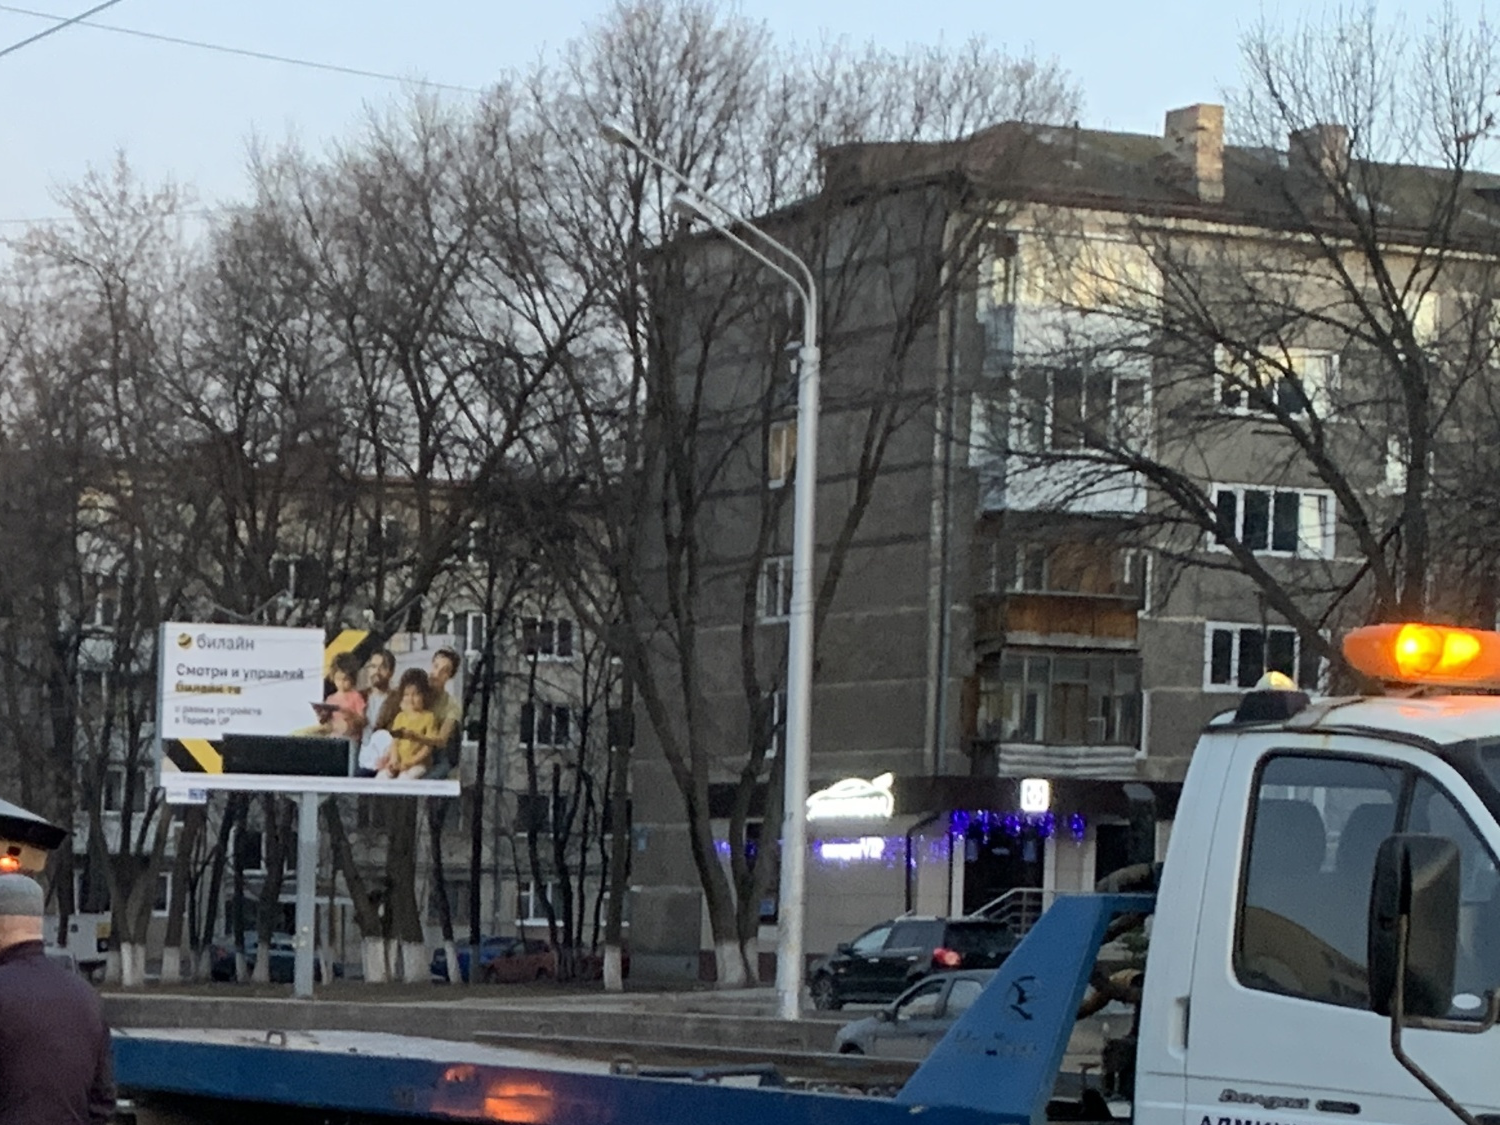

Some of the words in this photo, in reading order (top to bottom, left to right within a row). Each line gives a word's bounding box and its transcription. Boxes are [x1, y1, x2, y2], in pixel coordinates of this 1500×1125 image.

[197, 633, 255, 650] билайн
[176, 663, 228, 680] Смотри
[231, 669, 240, 678] и
[243, 668, 305, 682] управляй
